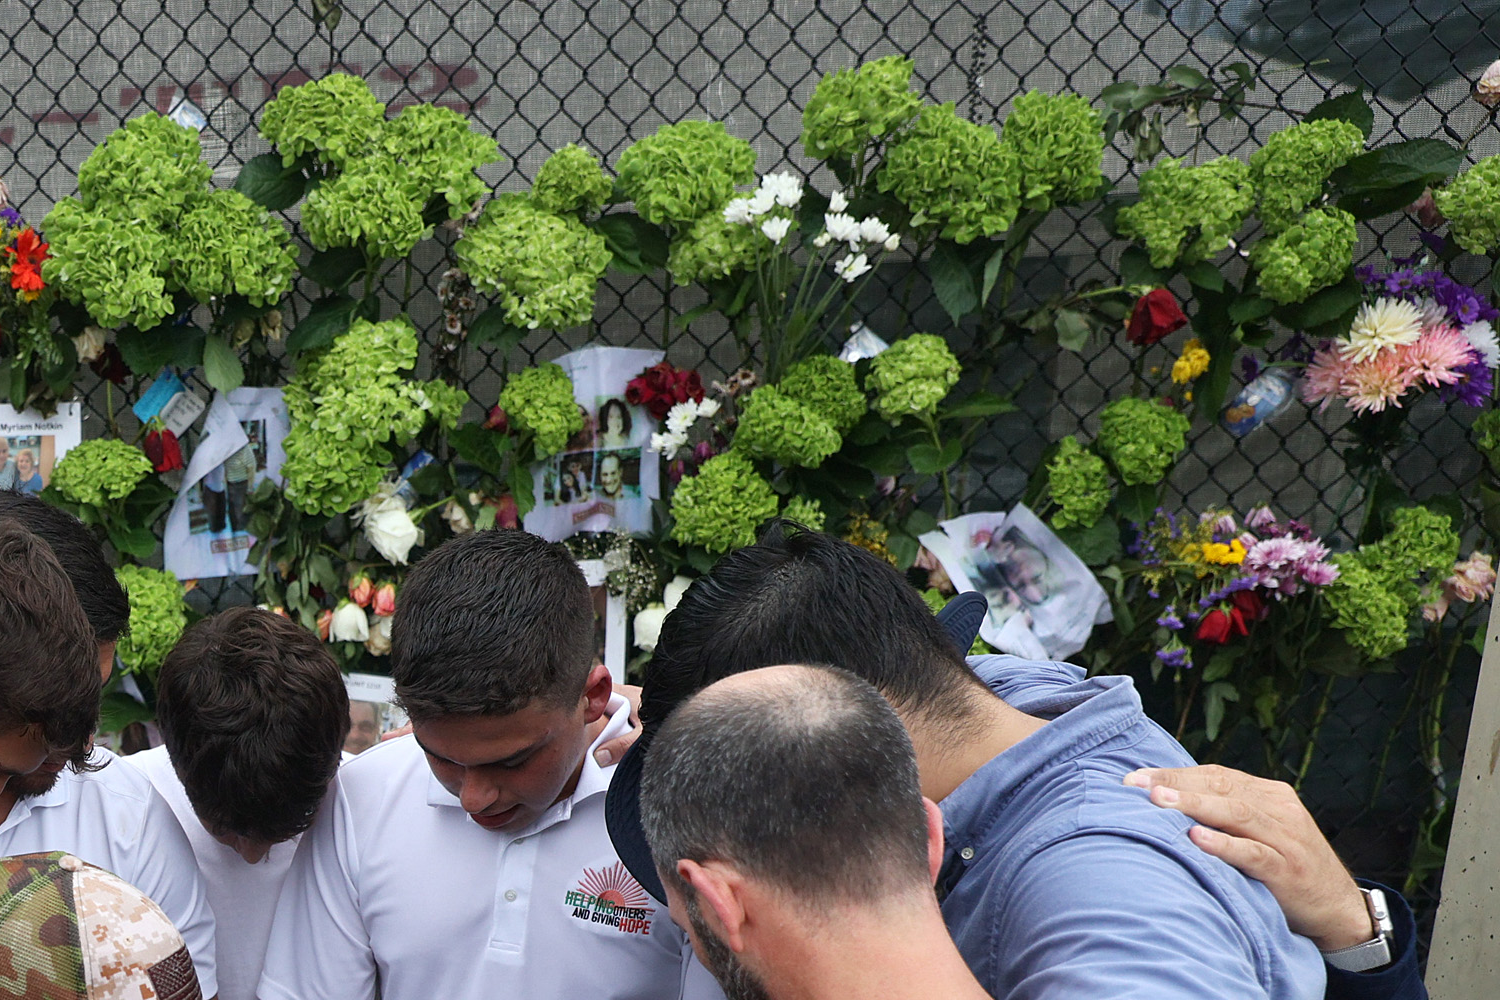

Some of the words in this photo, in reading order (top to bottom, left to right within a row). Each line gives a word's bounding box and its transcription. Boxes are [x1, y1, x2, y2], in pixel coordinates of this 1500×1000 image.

[0, 423, 33, 434] Myriam
[34, 422, 63, 431] Notkin
[564, 890, 616, 915] HELPING
[612, 905, 647, 921] OTHERS
[571, 906, 591, 921] AND
[591, 911, 620, 928] GIVING
[618, 917, 652, 935] HOPE
